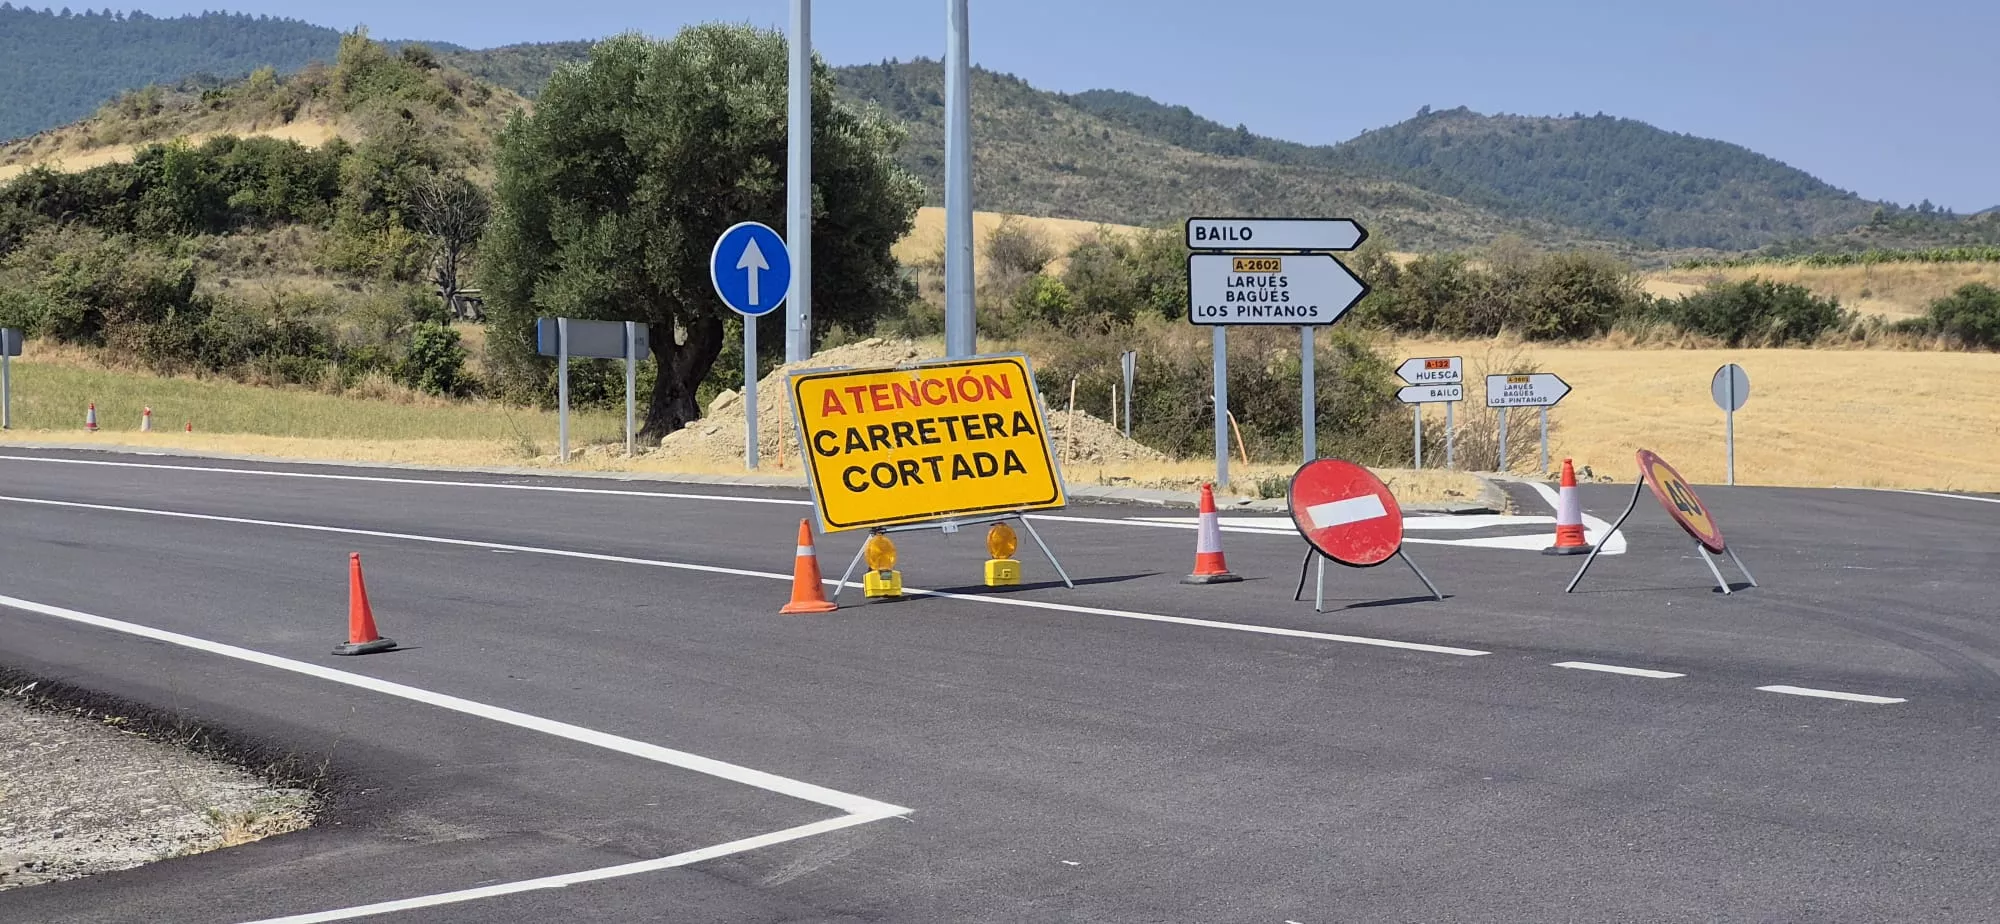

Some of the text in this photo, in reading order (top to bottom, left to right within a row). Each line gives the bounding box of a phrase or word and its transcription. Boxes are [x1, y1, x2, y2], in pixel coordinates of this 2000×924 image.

[1195, 226, 1253, 241] BAILO
[1235, 260, 1279, 271] A-2602
[1227, 273, 1288, 288] LARUÉS
[1226, 288, 1290, 302] BAGÜÉS
[1198, 305, 1318, 317] LOS PINTANOS
[1416, 371, 1459, 380] HUESCA
[822, 370, 1013, 418] ATENCIÓN
[1430, 388, 1459, 397] BAILO
[1508, 396, 1548, 404] PINTANOS
[813, 410, 1036, 457] CARRETERA
[842, 449, 1028, 493] CORTADA
[1664, 479, 1703, 516] 40
